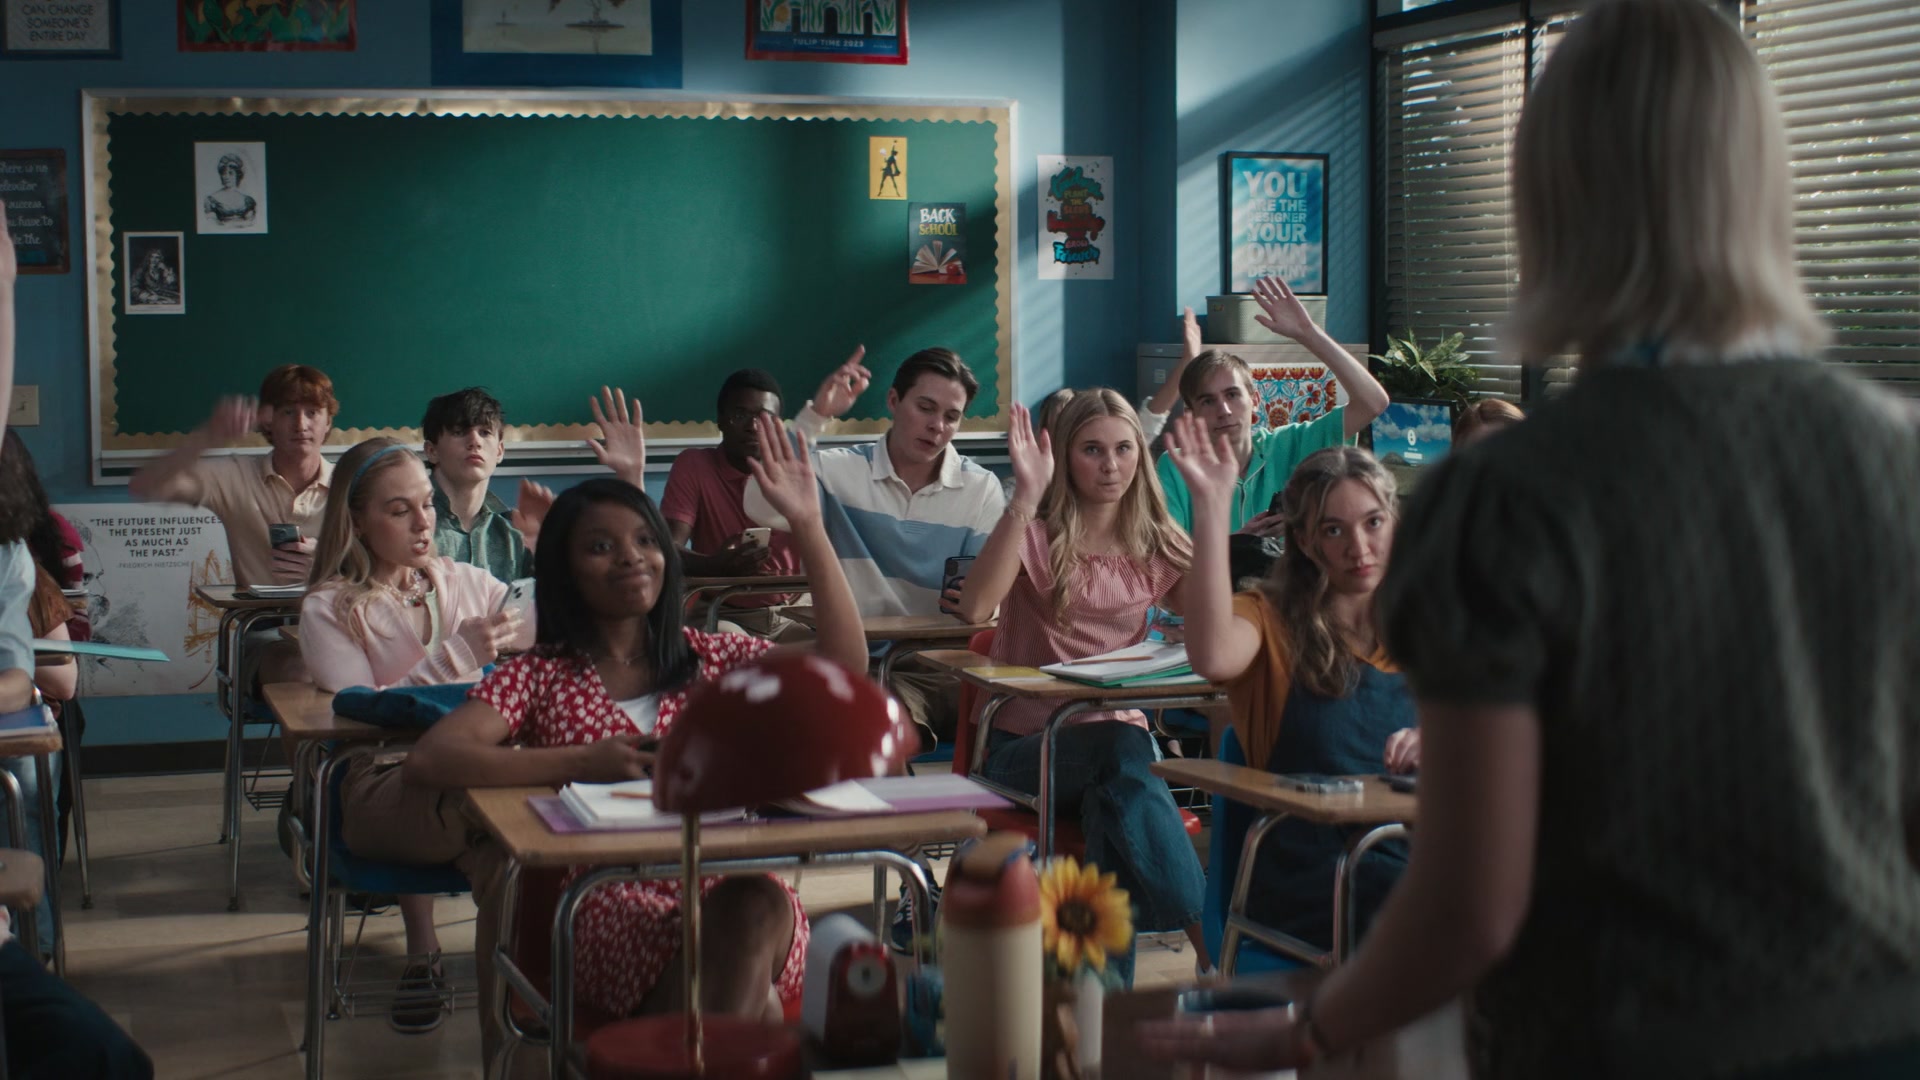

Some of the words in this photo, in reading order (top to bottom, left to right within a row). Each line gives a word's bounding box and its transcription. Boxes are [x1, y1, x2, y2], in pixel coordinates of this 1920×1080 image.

[22, 4, 45, 15] CAN
[47, 4, 95, 16] CHANGE
[27, 17, 90, 29] SOMEONE'S
[30, 30, 64, 41] ENTIRE
[66, 30, 87, 41] DAY
[793, 38, 818, 47] TULIP
[820, 39, 841, 47] TIME
[1243, 171, 1308, 199] YOU
[1248, 199, 1276, 212] ARE
[1279, 199, 1308, 212] THE
[920, 208, 956, 224] BACK
[1248, 212, 1307, 223] DESIGNER
[1248, 223, 1307, 242] YOUR
[1247, 242, 1307, 265] OWN
[1247, 264, 1307, 278] DESTINY
[118, 517, 156, 526] FUTURE
[109, 528, 128, 537] THE
[132, 527, 175, 536] PRESENT
[179, 527, 202, 535] JUST
[125, 539, 138, 547] AS
[142, 538, 172, 546] MUCH
[130, 549, 148, 557] THE
[154, 560, 190, 568] NIETZSCHE
